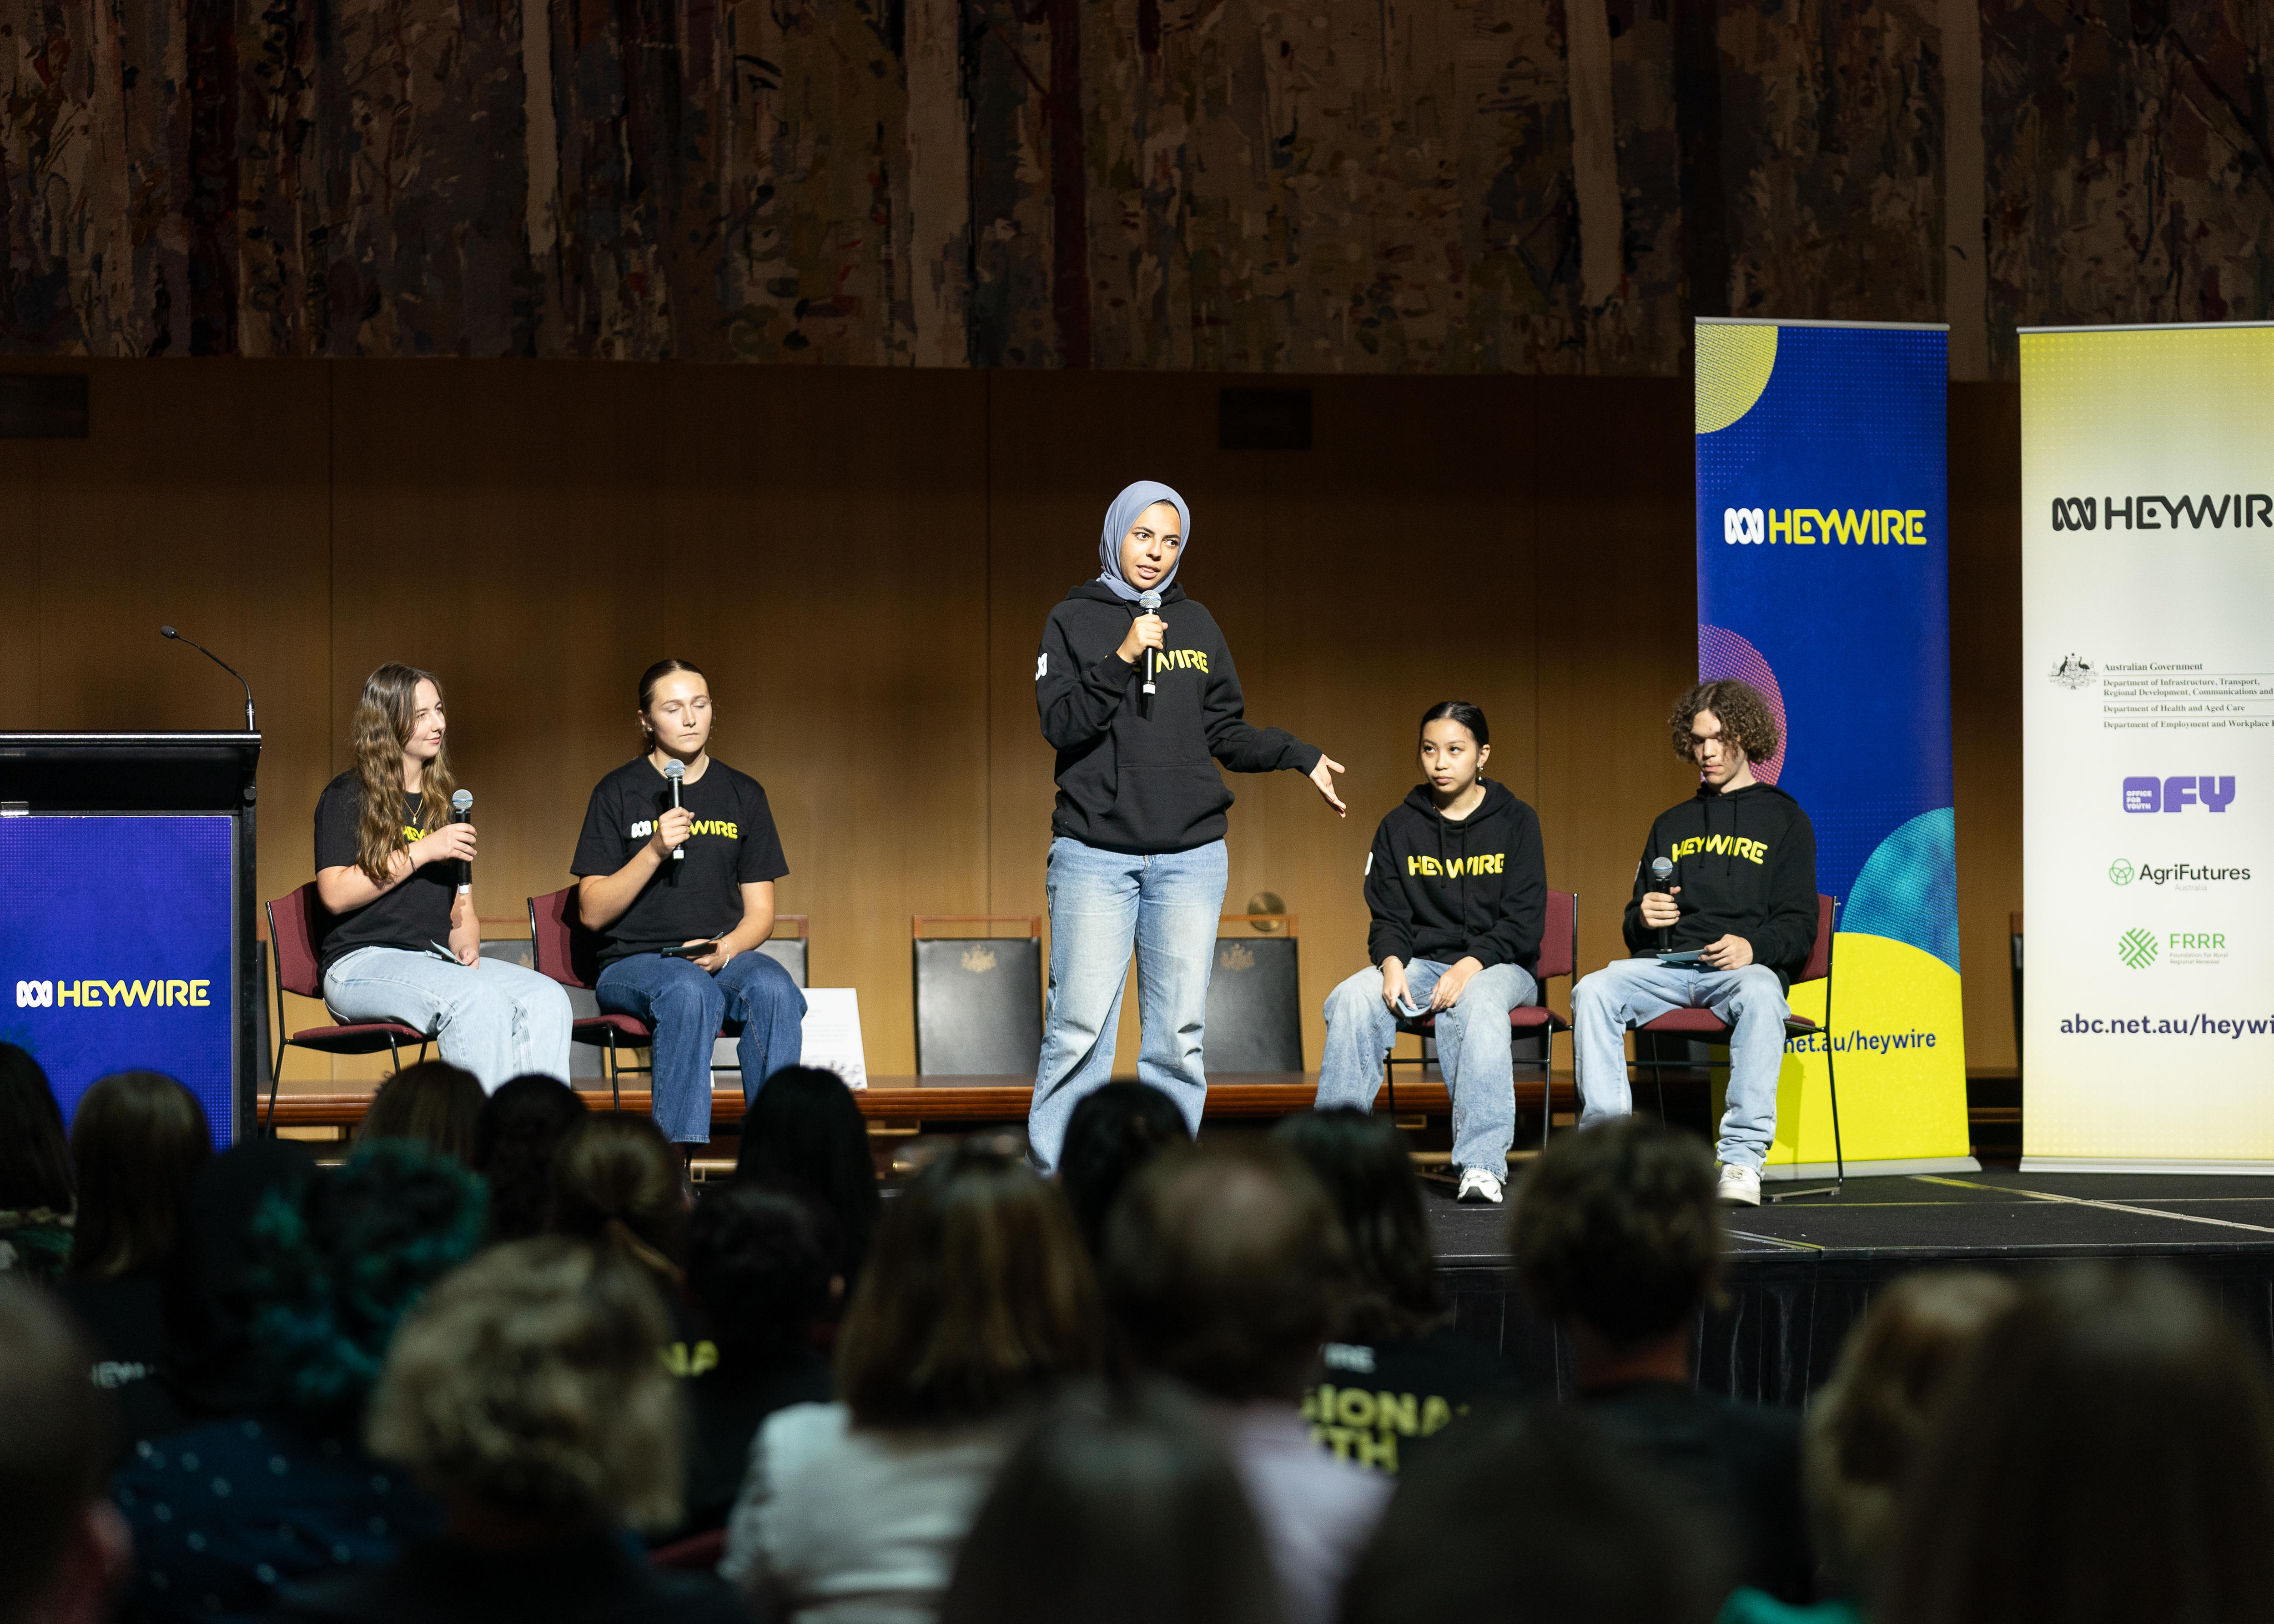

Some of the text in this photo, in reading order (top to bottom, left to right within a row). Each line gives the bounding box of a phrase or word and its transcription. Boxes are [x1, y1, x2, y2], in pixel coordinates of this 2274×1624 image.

[2105, 494, 2273, 530] HEYWIR
[1769, 508, 1927, 545] HEYWIRE
[2103, 662, 2203, 671] Australian Government
[2219, 678, 2260, 686] Transport,
[2103, 689, 2137, 697] Regional
[2139, 689, 2191, 697] Development,
[2206, 704, 2224, 712] Aged
[2103, 721, 2148, 729] Department
[2161, 721, 2209, 729] Employment
[2229, 720, 2269, 729] Workplace
[653, 820, 738, 840] WIRE
[1672, 834, 1768, 865] HEYWIRE
[2139, 864, 2251, 885] AgriFutures
[2170, 933, 2225, 949] FRRR
[57, 980, 211, 1007] HEYWIRE
